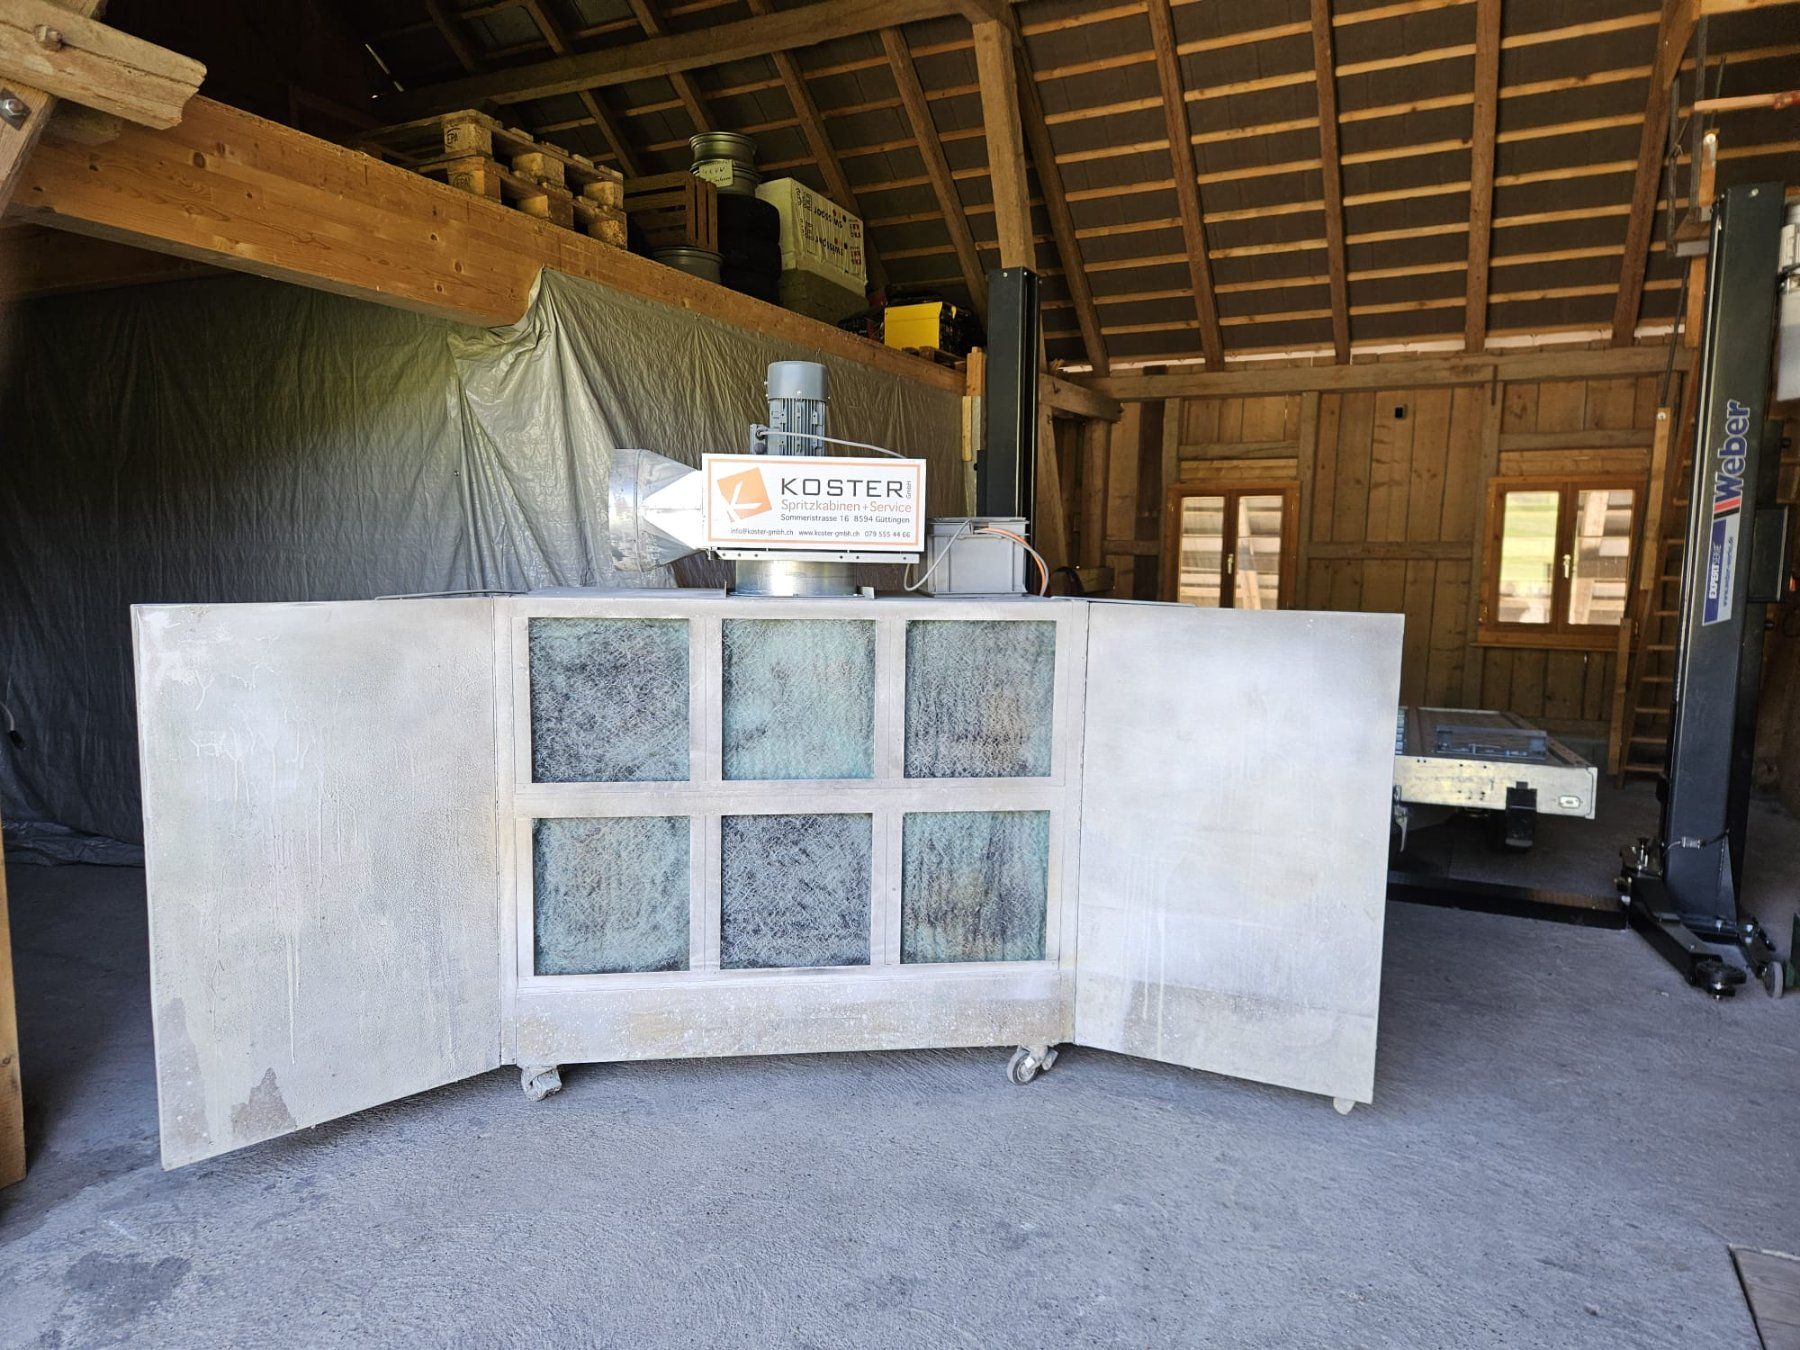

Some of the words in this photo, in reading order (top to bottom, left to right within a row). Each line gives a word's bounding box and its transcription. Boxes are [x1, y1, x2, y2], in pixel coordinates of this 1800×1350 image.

[1713, 399, 1750, 503] Weber
[781, 478, 904, 498] KOSTER
[781, 499, 861, 512] Spritzkabinen
[869, 500, 912, 513] Service
[780, 513, 838, 522] Sommeristrasse
[840, 514, 850, 522] 16
[853, 515, 874, 523] 8594
[875, 515, 910, 525] Güttingen
[798, 529, 860, 538] www.kostergmbh.ch
